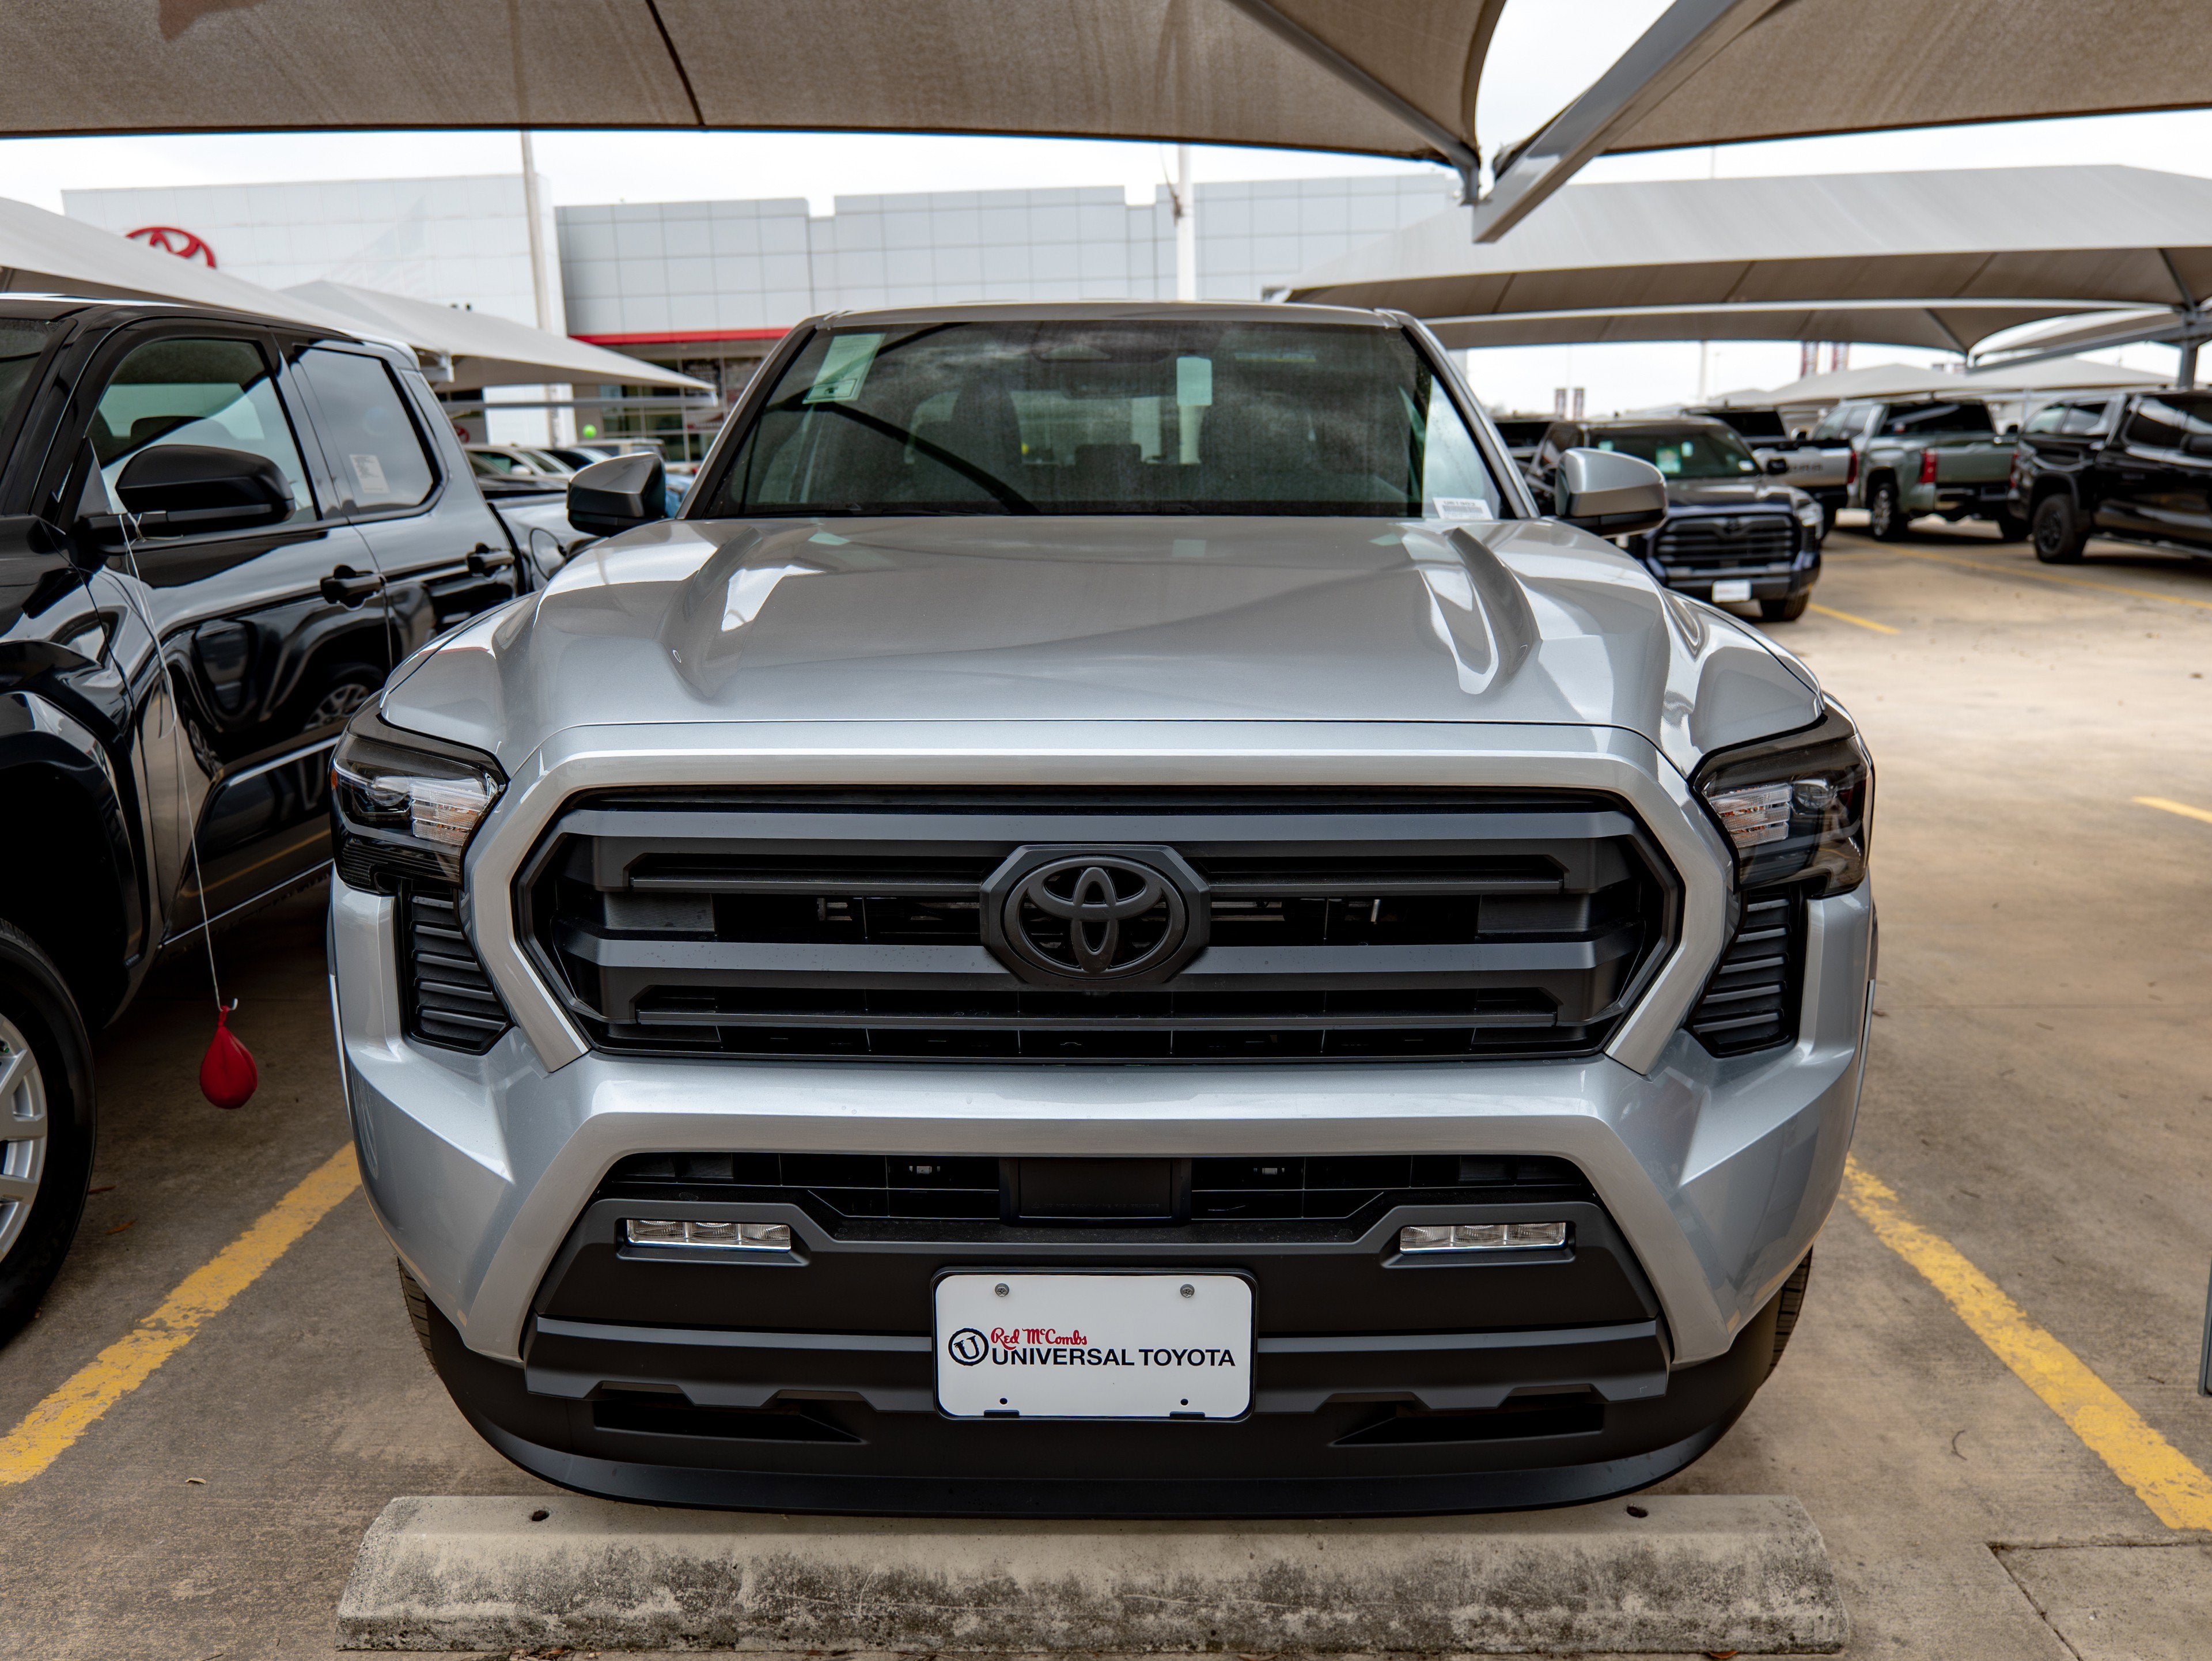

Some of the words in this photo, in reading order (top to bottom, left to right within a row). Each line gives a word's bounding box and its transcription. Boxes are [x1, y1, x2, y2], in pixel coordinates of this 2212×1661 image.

[990, 1327, 1020, 1350] Red
[1021, 1328, 1088, 1345] McCombs
[992, 1348, 1135, 1366] UNIVERSAL
[1138, 1349, 1236, 1367] TOYOTA
